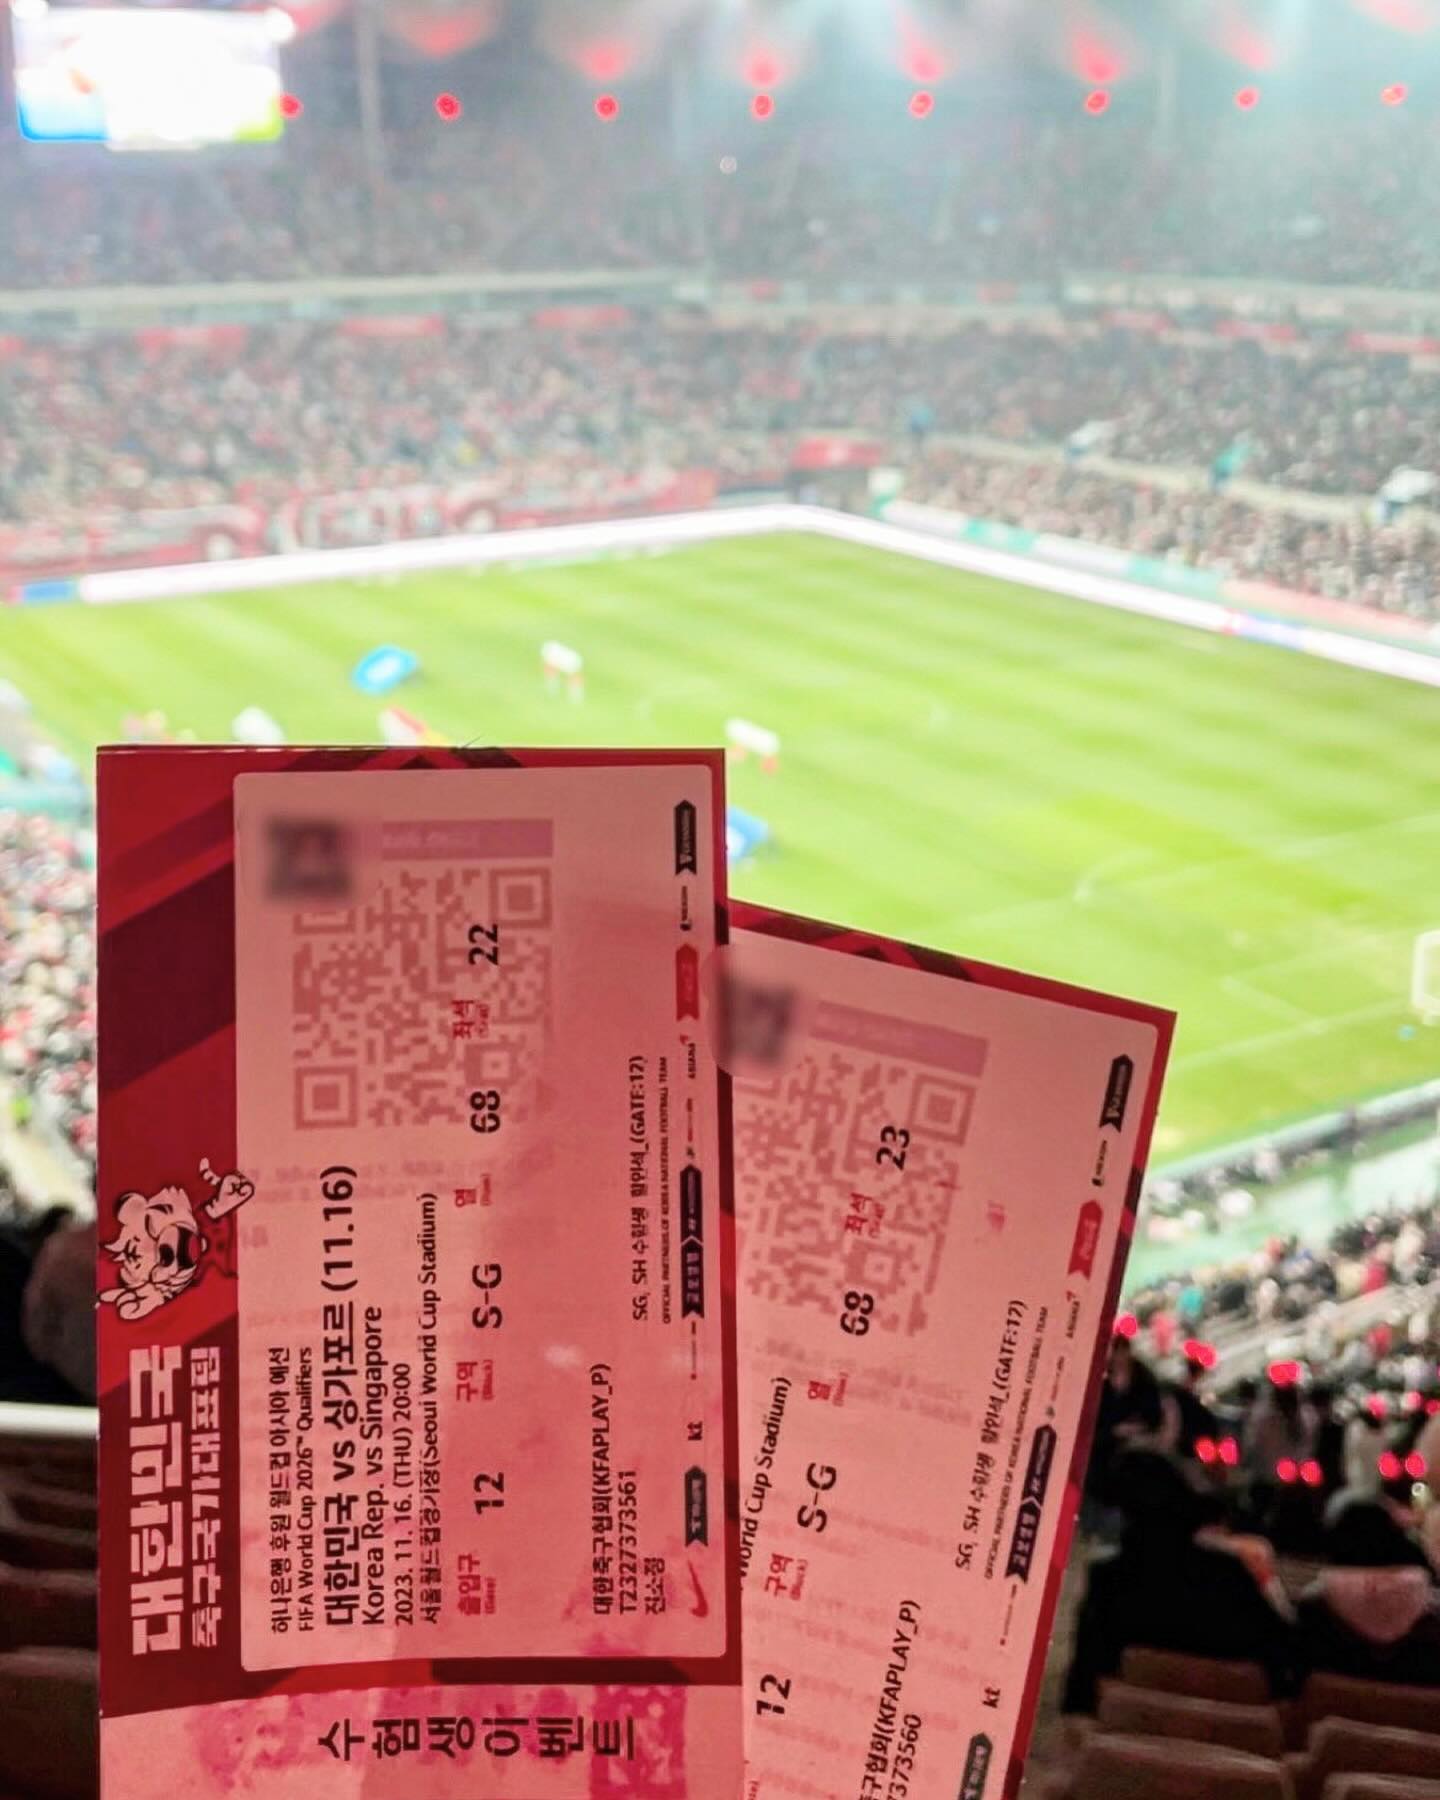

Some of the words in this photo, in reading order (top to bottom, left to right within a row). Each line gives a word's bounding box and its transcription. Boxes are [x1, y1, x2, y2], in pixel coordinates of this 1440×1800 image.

[468, 923, 499, 966] 22
[451, 999, 475, 1039] 좌석
[658, 1056, 668, 1082] TEAM
[470, 1089, 502, 1133] 68
[876, 1125, 911, 1171] 23
[454, 1188, 477, 1208] 열
[844, 1192, 873, 1235] 좌석
[320, 1165, 359, 1292] (11.16)
[416, 1192, 438, 1284] Stadium)
[632, 1260, 648, 1284] SH
[418, 1289, 441, 1329] Cup
[472, 1262, 504, 1329] S-G
[632, 1291, 651, 1320] SG,
[840, 1291, 875, 1336] 68
[1035, 1306, 1048, 1334] TEAM
[268, 1346, 291, 1385] 예선
[322, 1300, 359, 1430] 싱가포르
[360, 1305, 390, 1440] Singapore
[418, 1334, 438, 1395] World
[456, 1360, 479, 1402] 구역
[296, 1346, 316, 1431] Qualifiers
[392, 1362, 412, 1421] 20:00
[808, 1380, 833, 1401] 열
[268, 1389, 291, 1446] 아시아
[688, 1420, 704, 1441] kt
[754, 1377, 793, 1469] Stadium)
[333, 1440, 356, 1481] vs
[366, 1445, 384, 1475] vs
[393, 1426, 415, 1487] (THU)
[130, 1344, 184, 1655] 대한민국
[269, 1451, 292, 1508] 월드컵
[474, 1472, 505, 1514] 12
[590, 1363, 614, 1615] 대한축구협회(KFAPLAY_P)
[745, 1471, 772, 1513] Cup
[797, 1463, 837, 1533] S-G
[298, 1494, 318, 1530] Cup
[361, 1482, 390, 1539] Rep.
[394, 1494, 414, 1523] 16.
[963, 1506, 981, 1533] SH
[270, 1513, 292, 1552] 후원
[395, 1530, 414, 1561] 11.
[618, 1470, 638, 1614] T2327373561
[297, 1533, 315, 1588] World
[324, 1492, 361, 1625] 대한민국
[765, 1553, 794, 1597] 구역
[955, 1542, 979, 1570] SG,
[270, 1556, 293, 1633] 하나은행
[362, 1547, 386, 1625] Korea
[395, 1567, 414, 1626] 2023.
[458, 1552, 482, 1616] 출입구
[299, 1593, 315, 1631] FIFA
[756, 1674, 792, 1715] 12
[982, 1687, 1001, 1709] kt
[318, 1715, 634, 1761] 수험생이벤트
